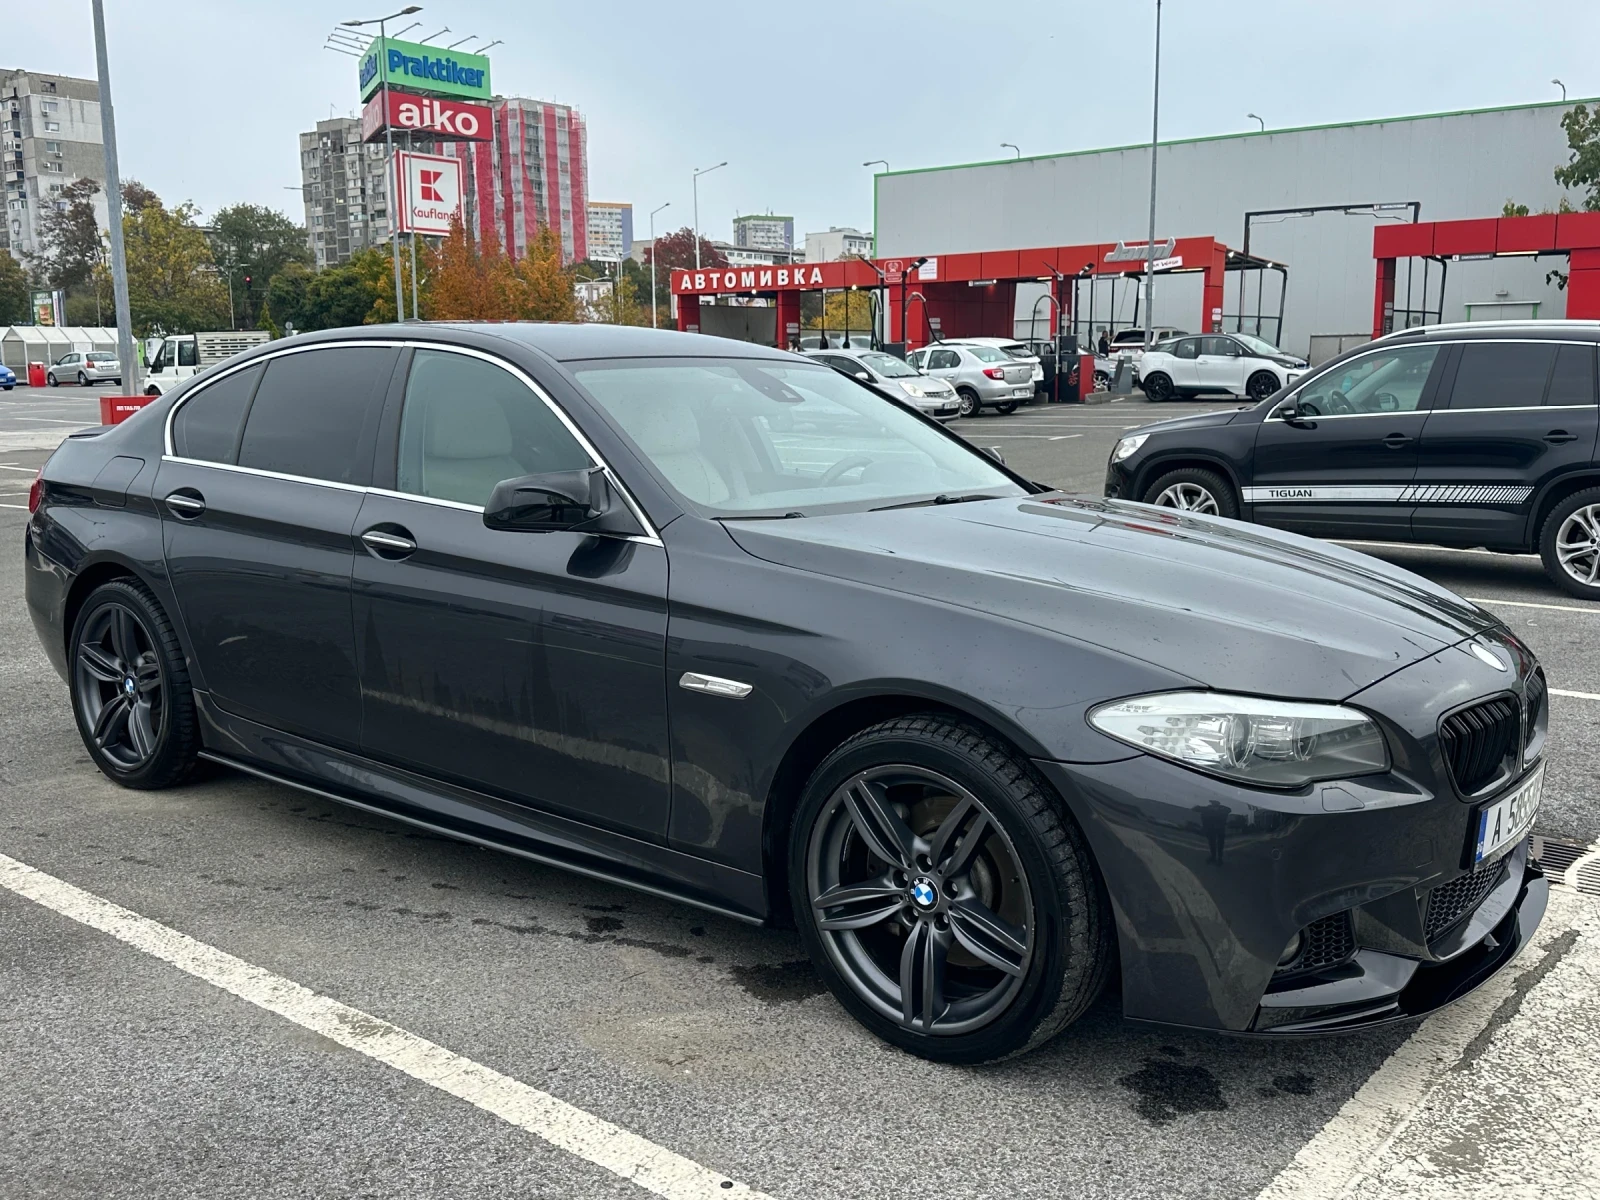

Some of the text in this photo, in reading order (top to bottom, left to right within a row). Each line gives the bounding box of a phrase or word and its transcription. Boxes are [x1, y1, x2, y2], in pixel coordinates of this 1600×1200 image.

[388, 49, 485, 88] Praktiker
[398, 98, 479, 136] aiko
[680, 267, 824, 290] АВТОМИВКА
[1269, 489, 1312, 498] TIGUAN
[1491, 806, 1502, 846] A
[910, 877, 929, 895] BMW
